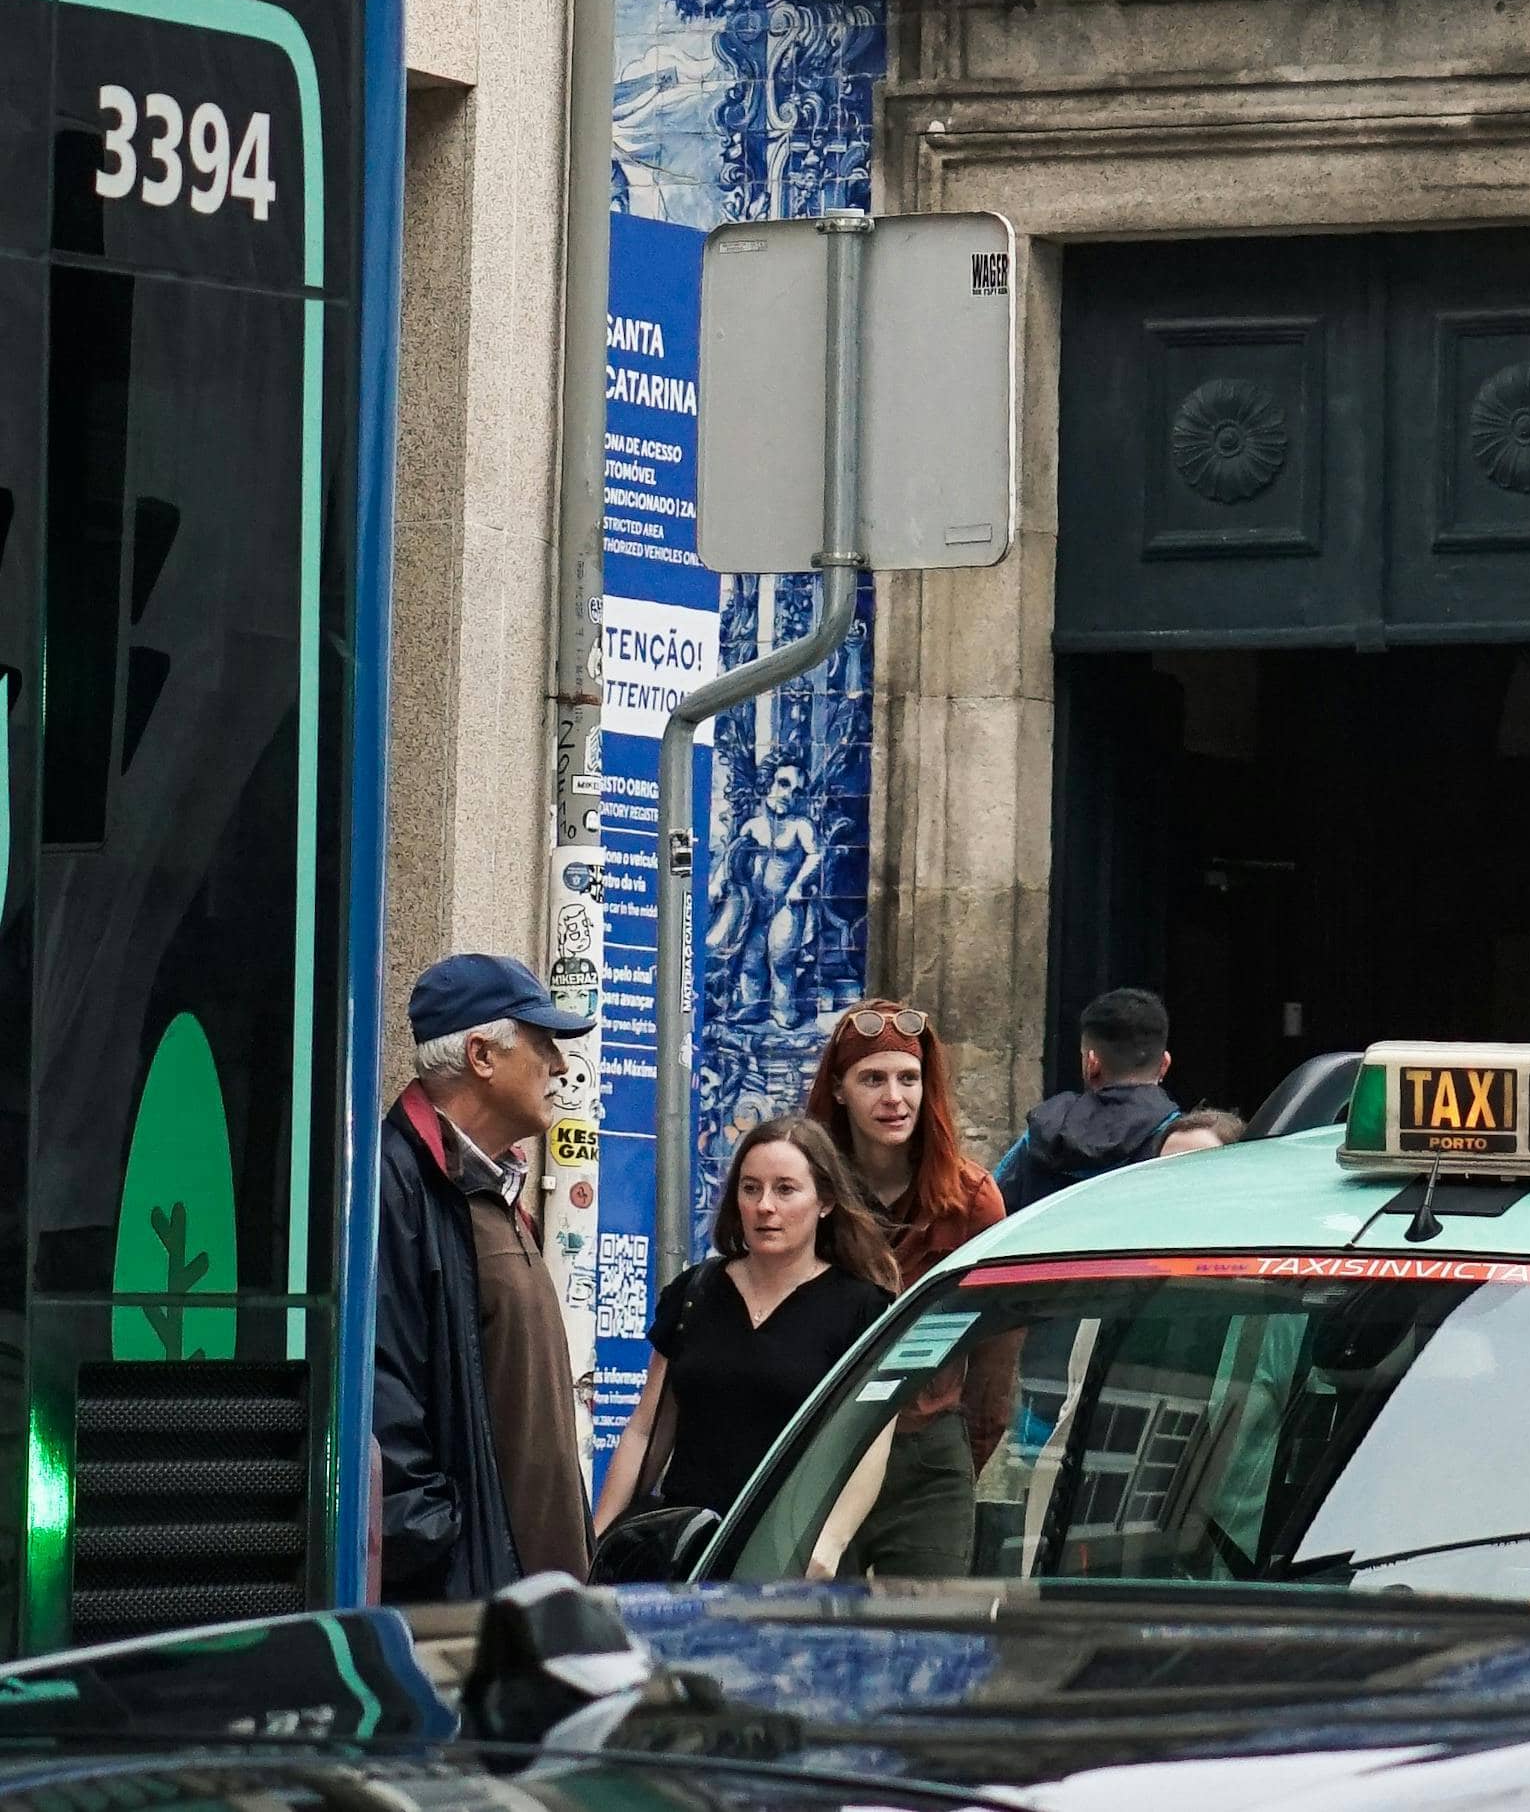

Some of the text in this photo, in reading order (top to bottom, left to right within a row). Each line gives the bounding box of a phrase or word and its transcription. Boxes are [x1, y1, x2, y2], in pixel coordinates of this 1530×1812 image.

[96, 84, 276, 221] 3394
[971, 253, 1008, 288] WAGER
[625, 436, 641, 457] DE
[641, 440, 683, 464] ACESSO
[1405, 1069, 1514, 1129] TAXI
[1428, 1136, 1487, 1150] PORTO
[1256, 1257, 1530, 1282] TAXISINVICTA
